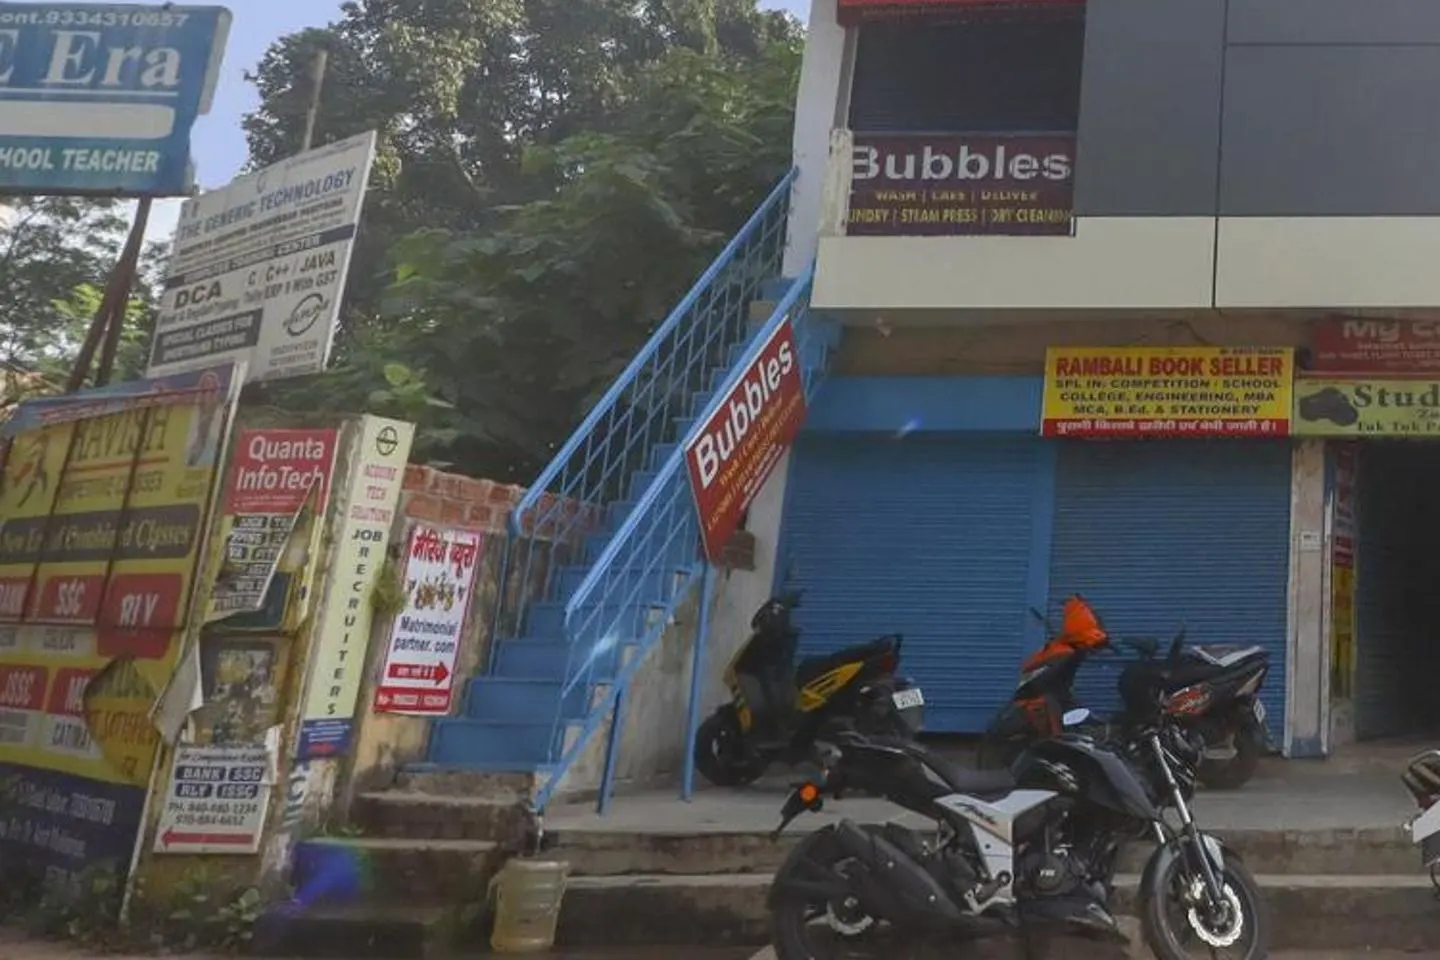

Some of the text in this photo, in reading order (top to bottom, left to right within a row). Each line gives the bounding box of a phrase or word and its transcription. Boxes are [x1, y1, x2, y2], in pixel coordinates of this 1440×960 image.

[38, 28, 181, 87] Era
[0, 147, 160, 172] HOOL TEACHER
[852, 144, 1072, 180] Bubbles
[205, 202, 256, 233] GENERIC
[260, 167, 356, 213] TECHNOLOGY
[850, 208, 889, 224] UNDRY
[900, 208, 941, 223] STEAM
[174, 281, 222, 310] DCA
[301, 250, 336, 273] JAVA
[1056, 355, 1283, 377] RAMBALI BOOK SELLER
[1111, 379, 1210, 388] COMPETITION
[1223, 379, 1280, 388] SCHOOL
[1244, 391, 1275, 401] MBA
[694, 339, 793, 489] Bubbles
[1170, 404, 1260, 414] STATIONERY
[249, 435, 325, 462] Quanta
[236, 464, 324, 491] InfoTech
[352, 528, 383, 542] JOB
[326, 545, 370, 716] RECRUITERS
[401, 615, 458, 637] Matrimonial
[183, 767, 262, 781] BANK SSC
